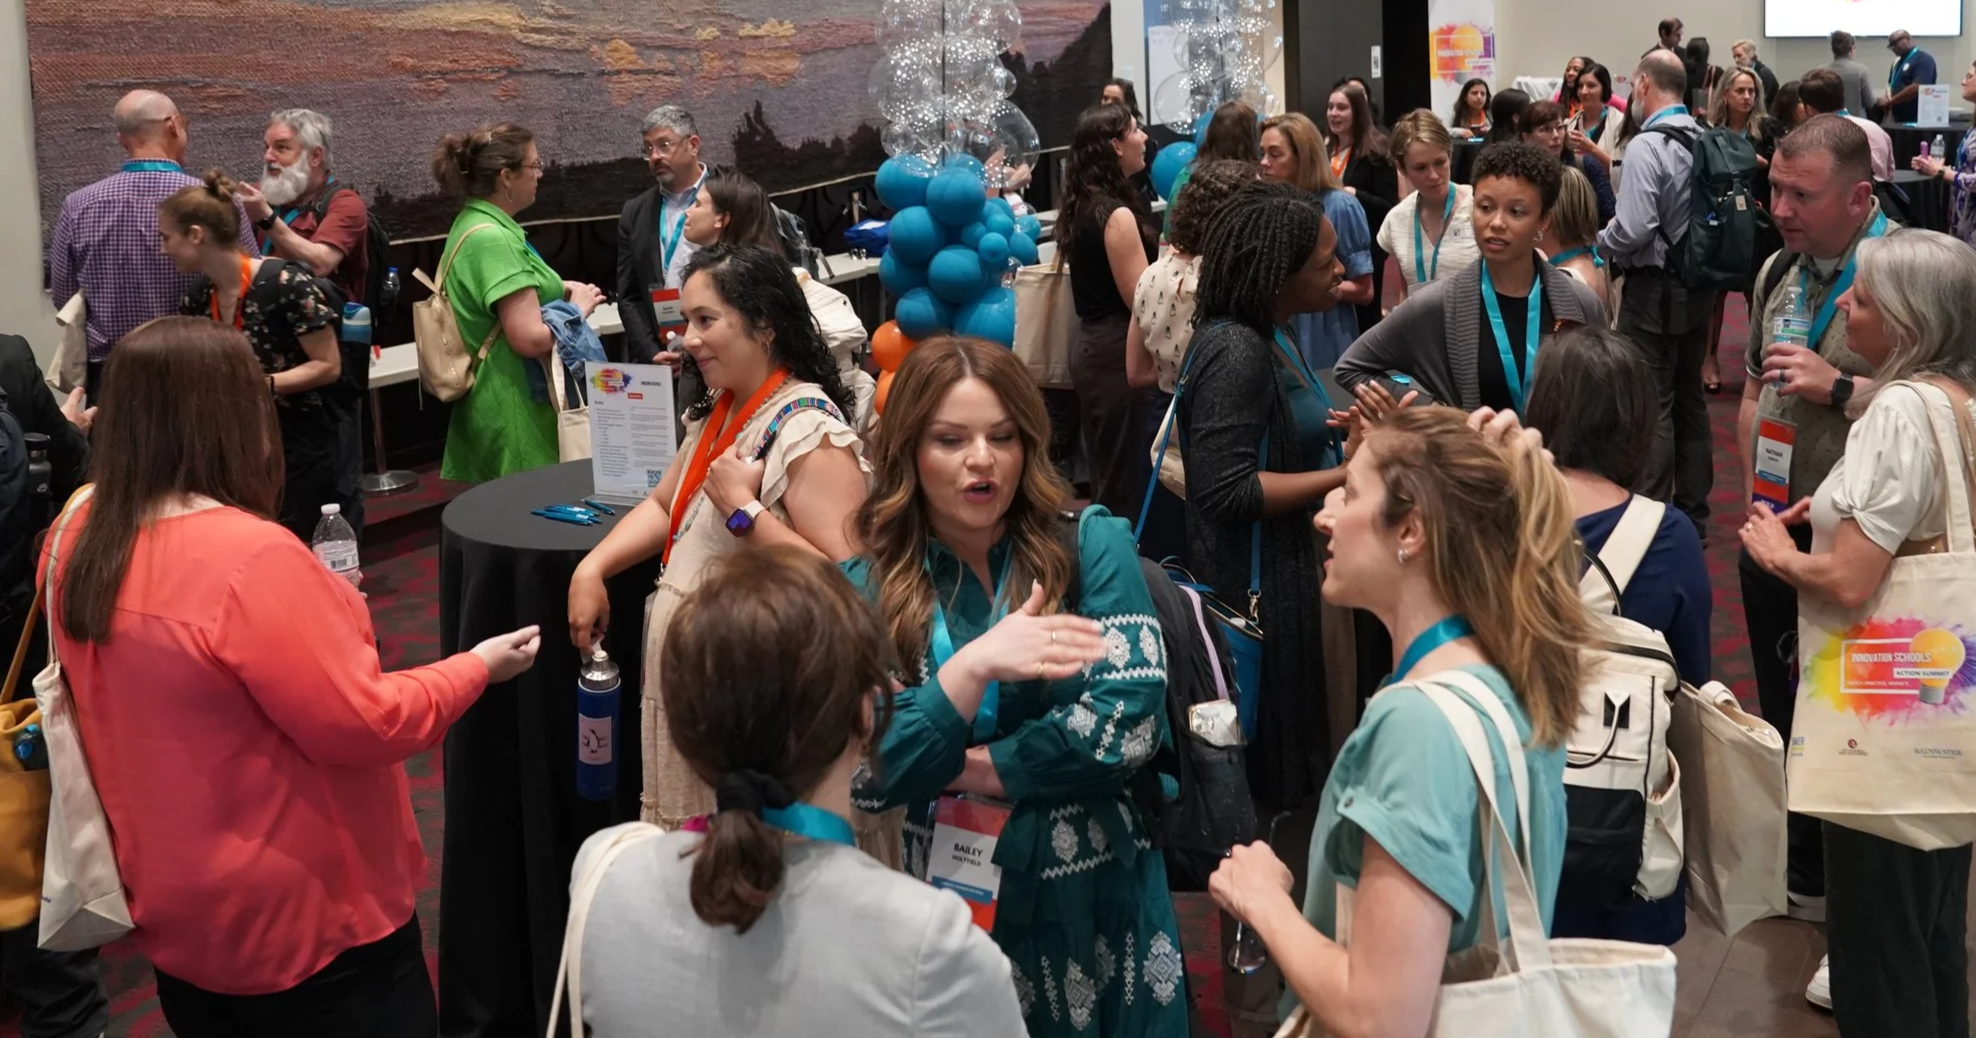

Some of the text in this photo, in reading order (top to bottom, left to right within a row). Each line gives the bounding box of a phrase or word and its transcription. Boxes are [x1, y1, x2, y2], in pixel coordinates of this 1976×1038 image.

[1766, 448, 1782, 458] NATHAN
[1851, 652, 1932, 663] INNOVATION SCHOOLS
[1913, 748, 1962, 756] RAINWATER
[954, 843, 983, 857] BAILEY
